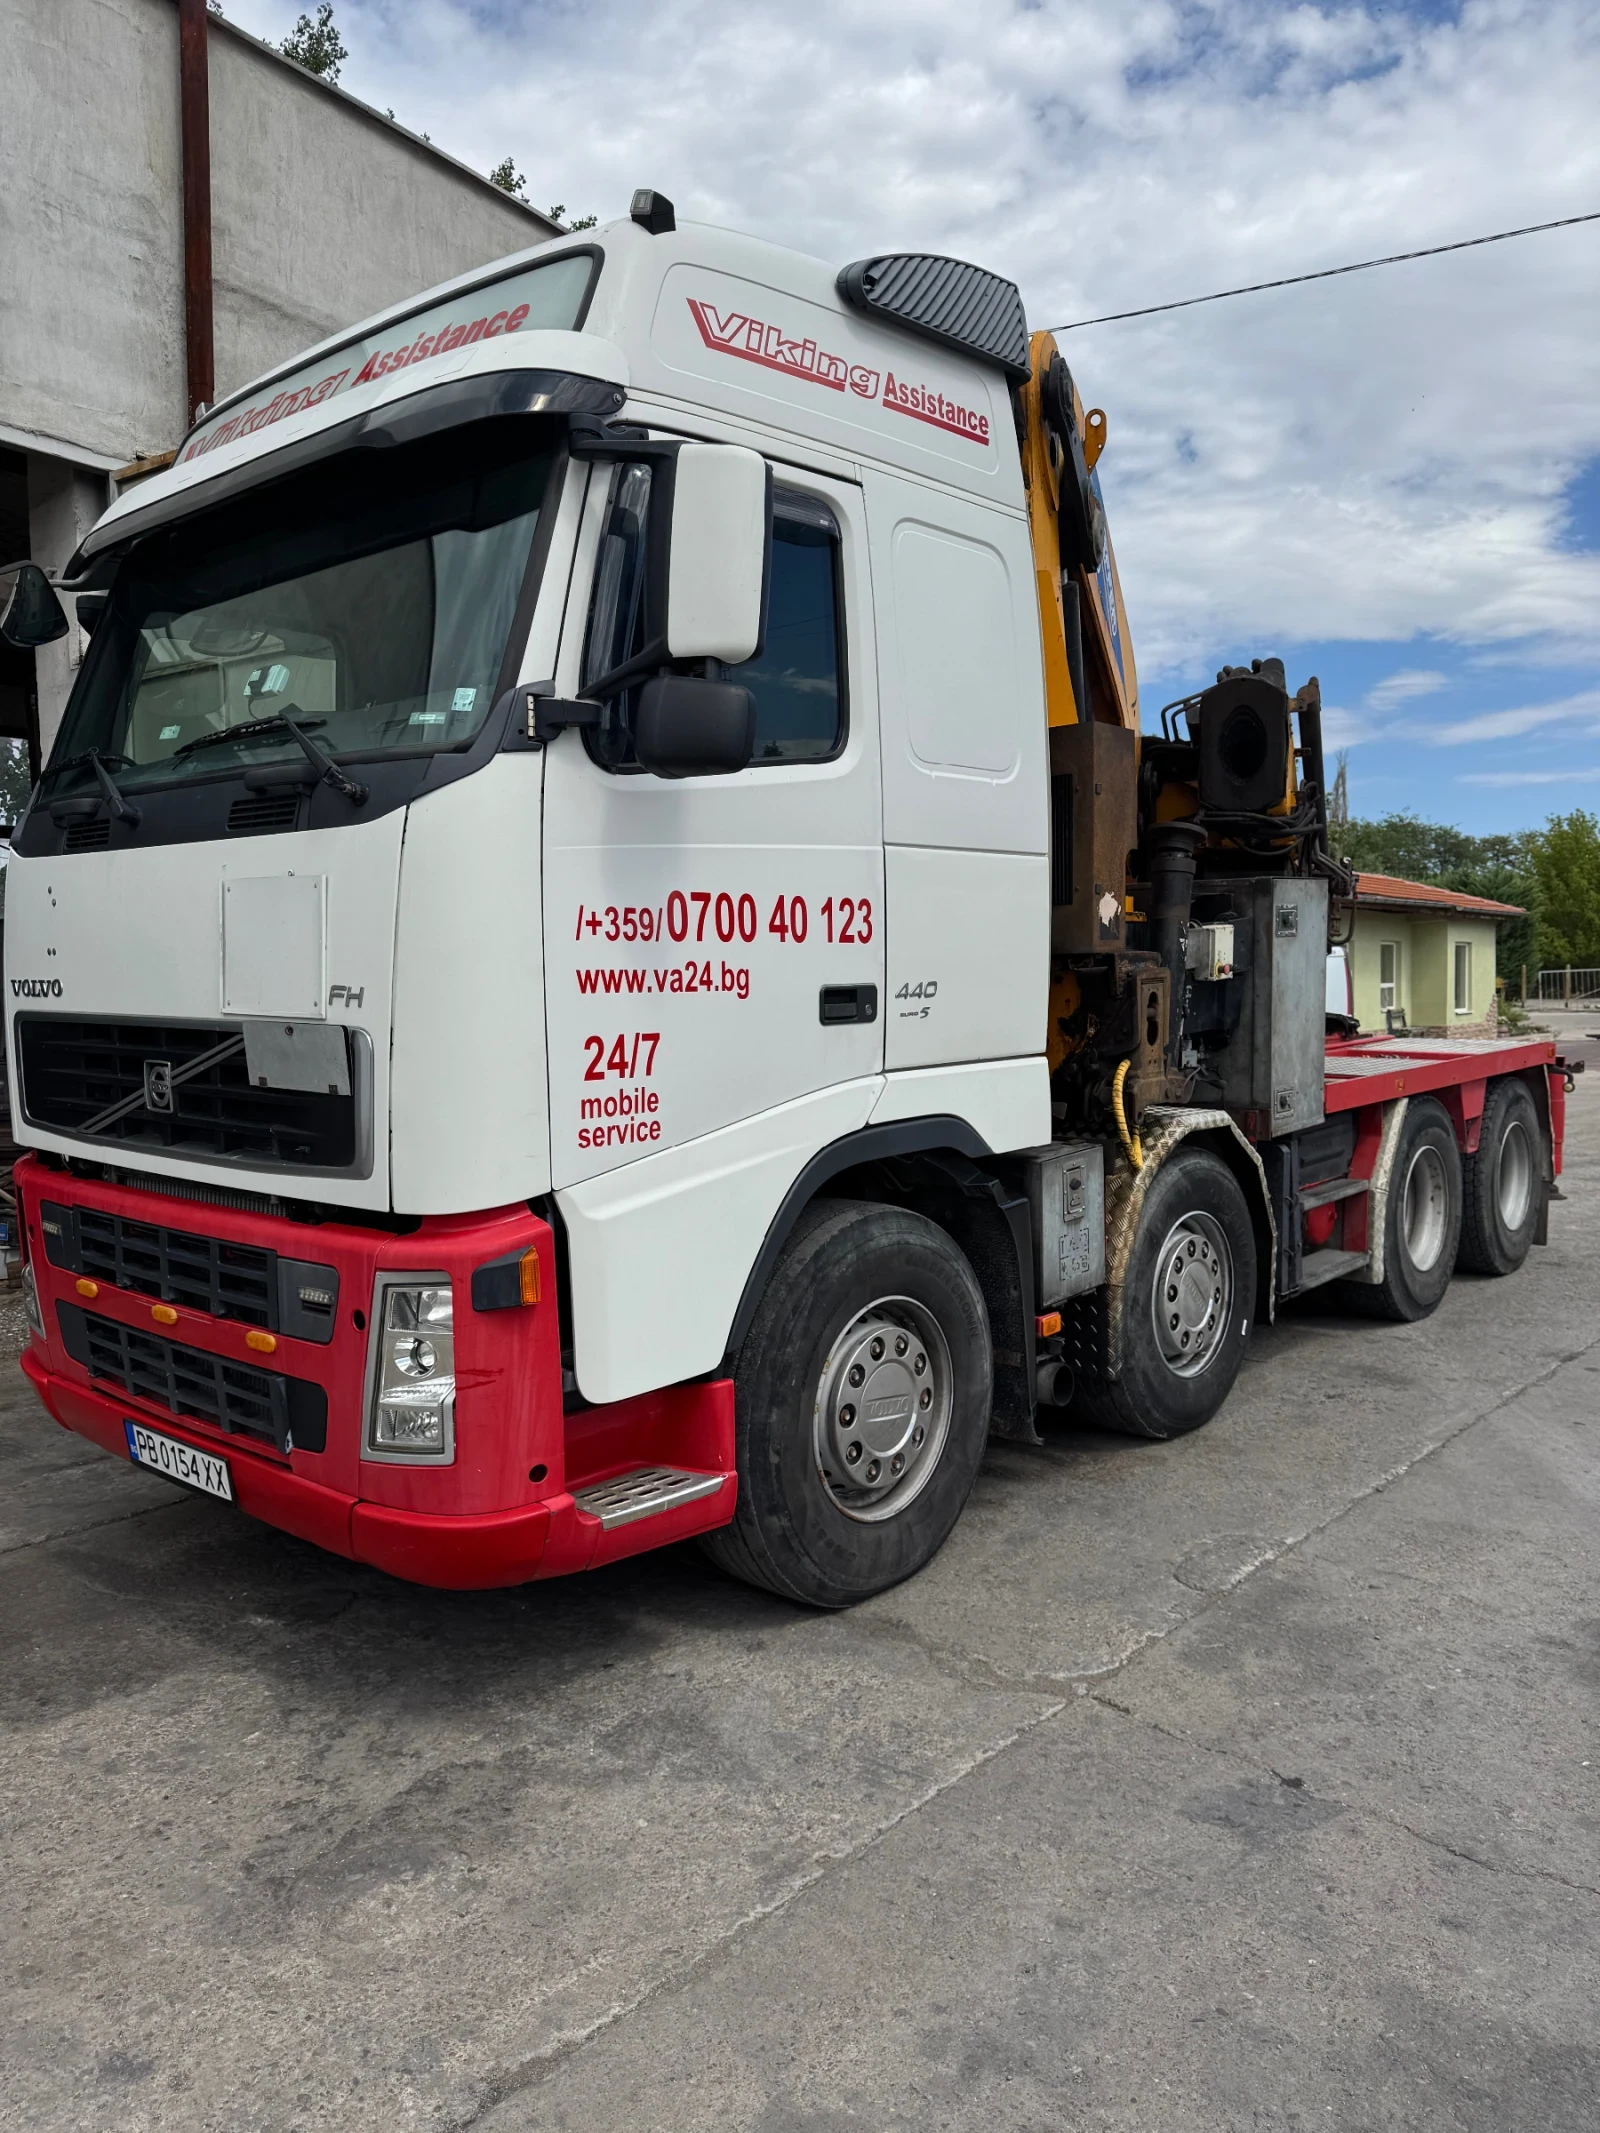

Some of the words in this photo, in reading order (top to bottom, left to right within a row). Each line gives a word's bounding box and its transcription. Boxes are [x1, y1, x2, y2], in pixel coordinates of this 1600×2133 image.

[351, 303, 530, 387] Assistance
[686, 298, 880, 399] Viking
[884, 372, 989, 436] Assistance
[768, 894, 808, 944] 40
[820, 896, 873, 944] 123
[11, 978, 63, 998] VOLVO
[328, 985, 364, 1008] FH
[576, 960, 750, 1000] www.va24.bg
[894, 980, 938, 1000] 440
[919, 1006, 931, 1019] 5
[583, 1032, 661, 1081] 24/7
[580, 1086, 659, 1120] mobile
[577, 1115, 661, 1149] service
